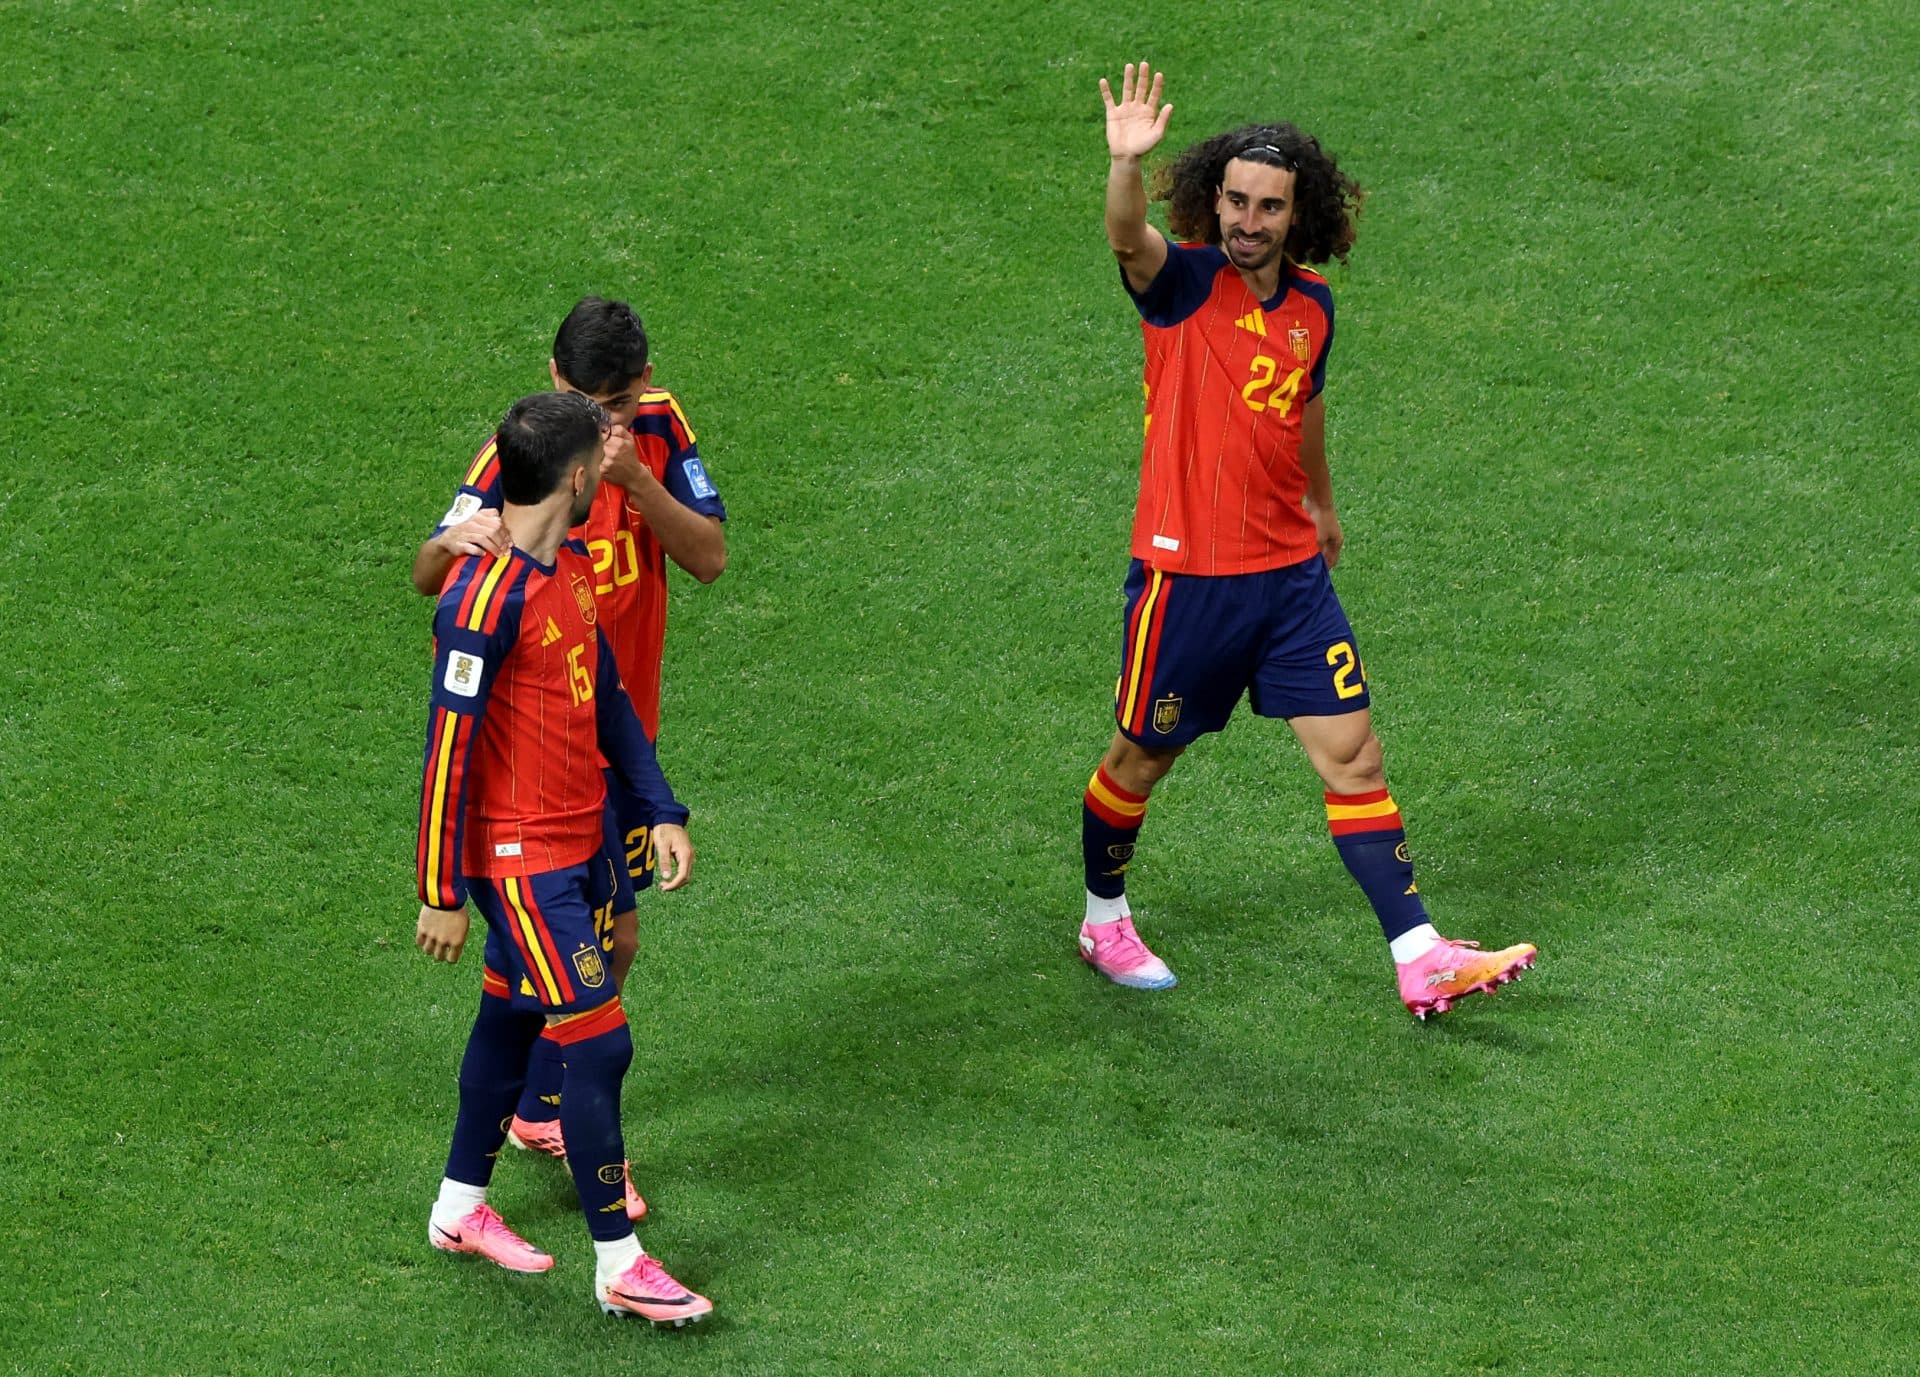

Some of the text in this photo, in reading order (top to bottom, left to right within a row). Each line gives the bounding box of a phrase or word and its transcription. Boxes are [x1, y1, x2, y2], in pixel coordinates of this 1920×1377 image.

[1242, 355, 1306, 418] 24
[587, 530, 639, 595] 20
[567, 643, 593, 707] 15
[1326, 641, 1366, 699] 2
